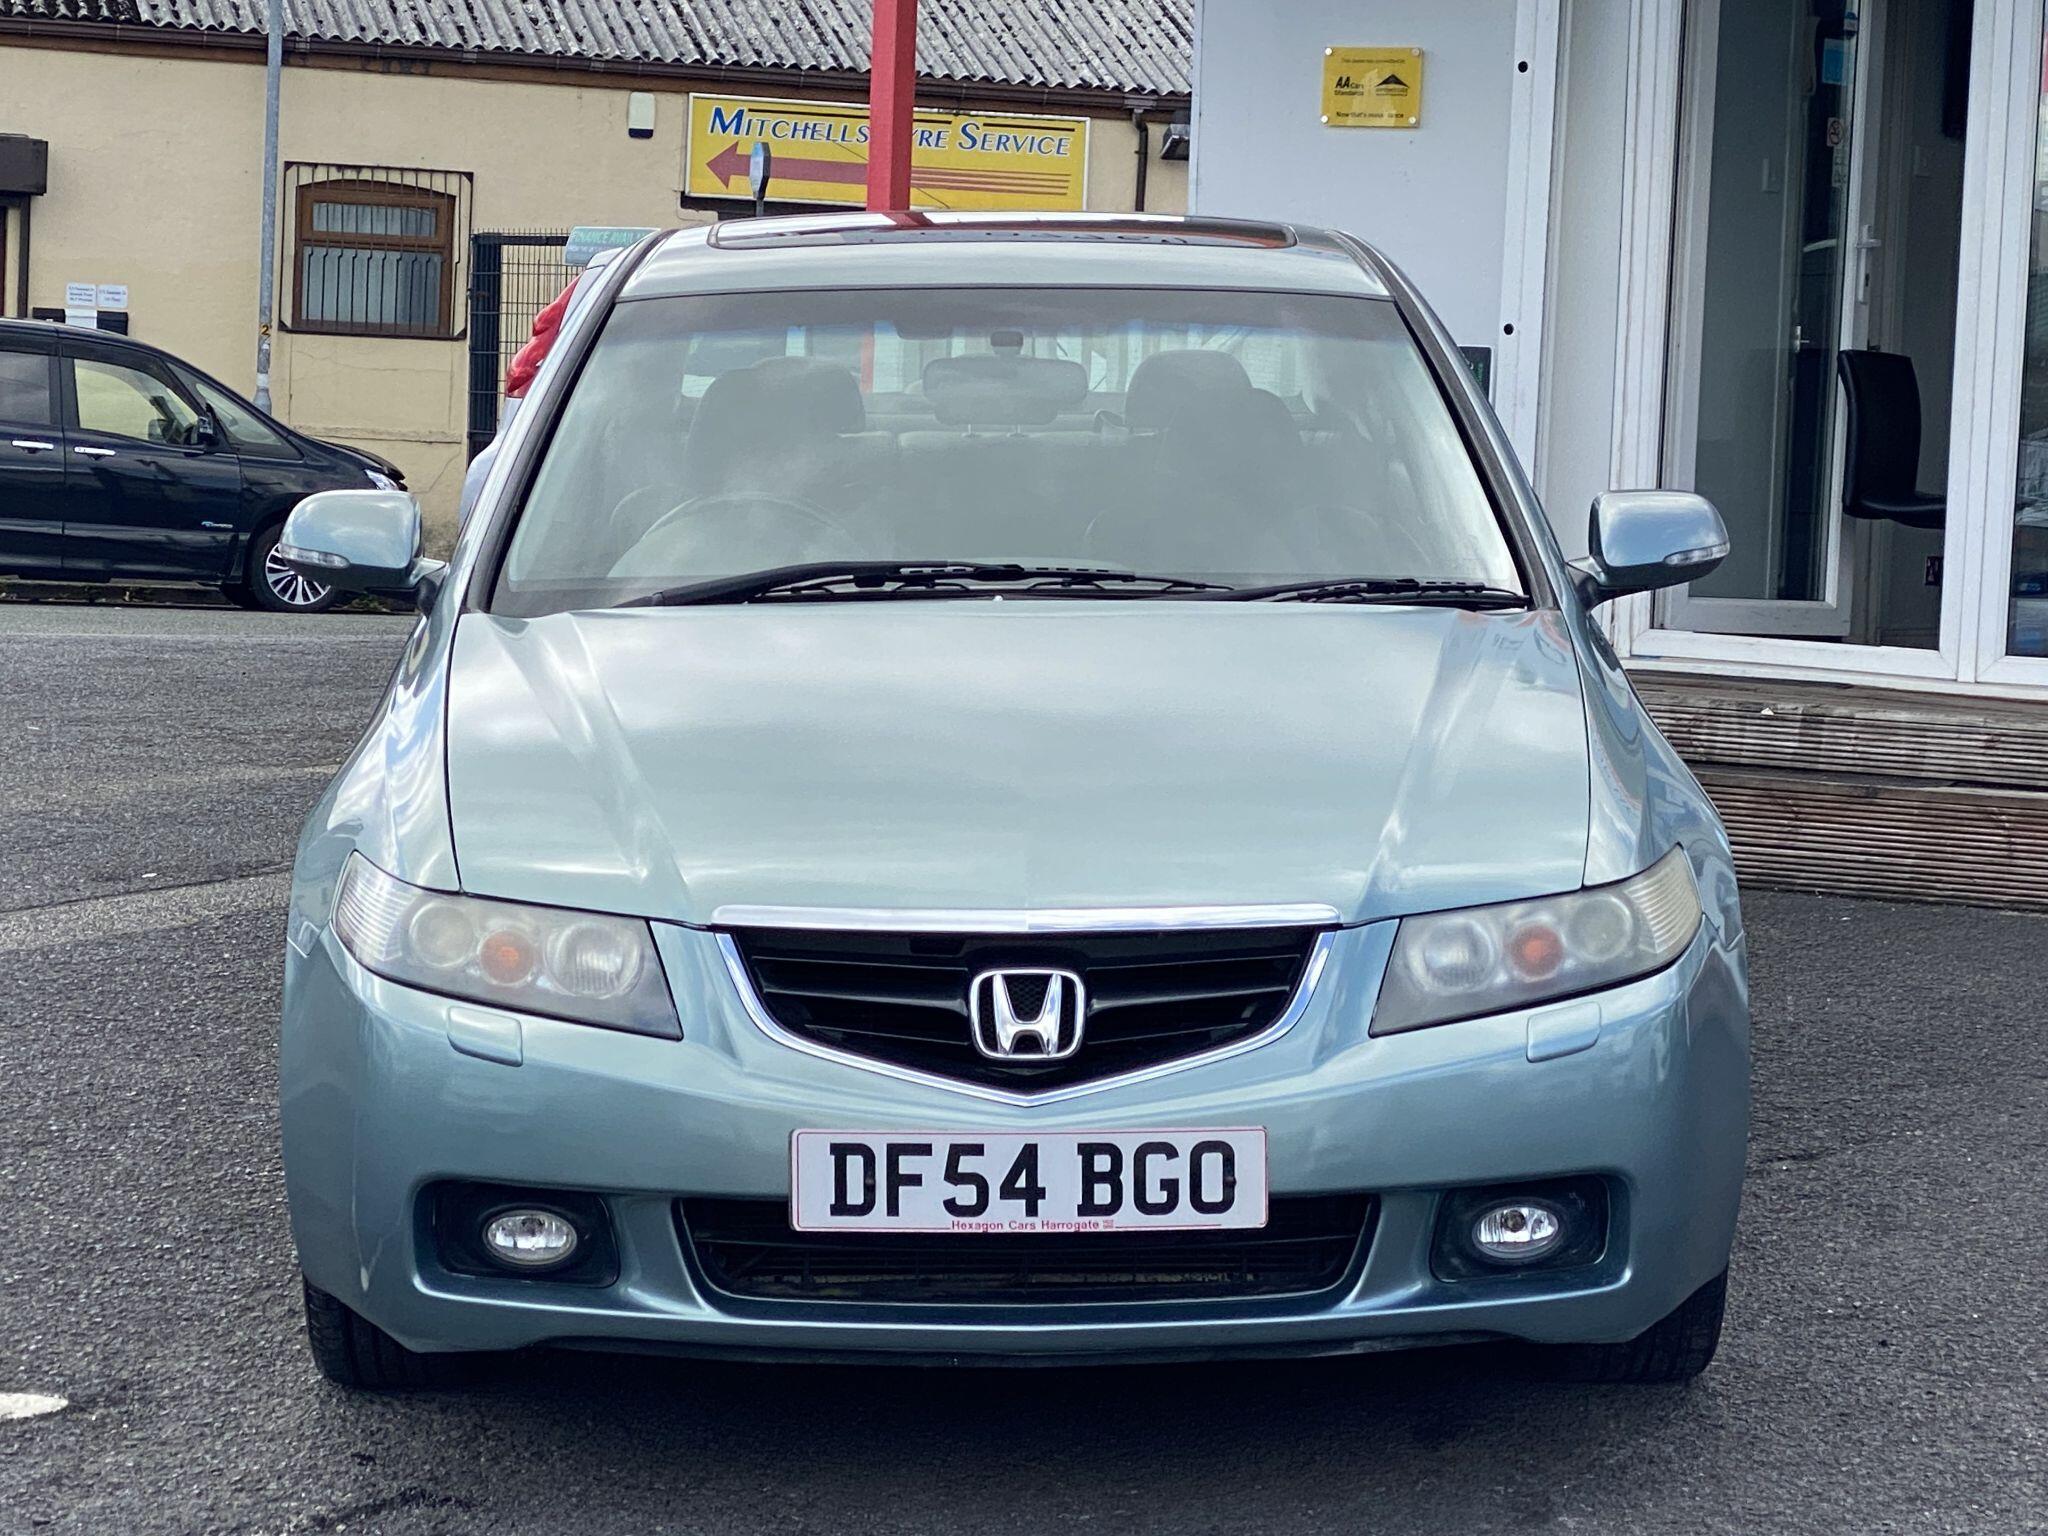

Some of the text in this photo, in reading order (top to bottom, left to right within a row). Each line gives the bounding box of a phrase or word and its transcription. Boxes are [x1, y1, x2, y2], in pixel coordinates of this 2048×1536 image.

[1335, 76, 1350, 88] AA
[708, 105, 1071, 156] MITCHELLS RE SERVICE
[570, 229, 609, 243] FINANCE
[829, 1139, 1237, 1218] DF54 BGO
[951, 1219, 1004, 1233] Hexagon
[1009, 1220, 1036, 1231] Cars
[1041, 1219, 1100, 1232] Harrogate
